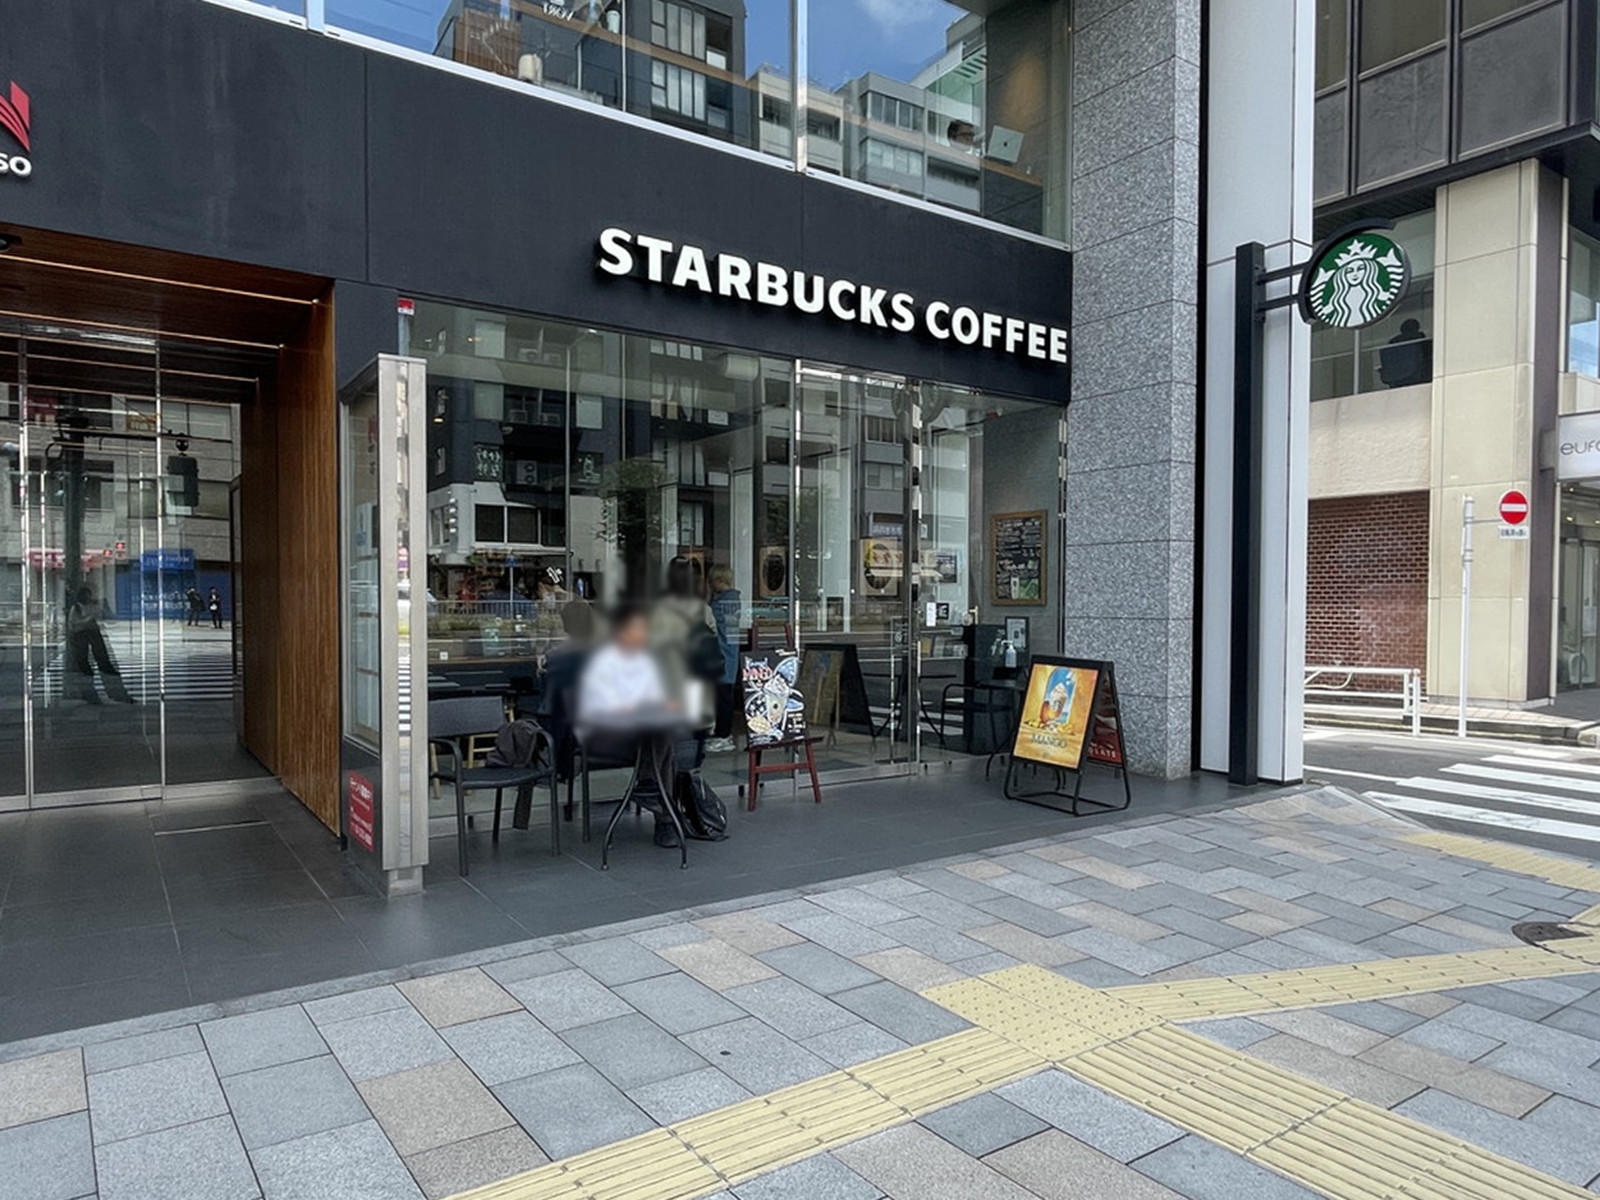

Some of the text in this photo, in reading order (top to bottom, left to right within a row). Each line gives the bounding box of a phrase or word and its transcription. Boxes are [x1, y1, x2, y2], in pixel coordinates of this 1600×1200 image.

[599, 228, 1068, 364] STARBUCKS COFFEE
[1030, 732, 1068, 749] MANGO
